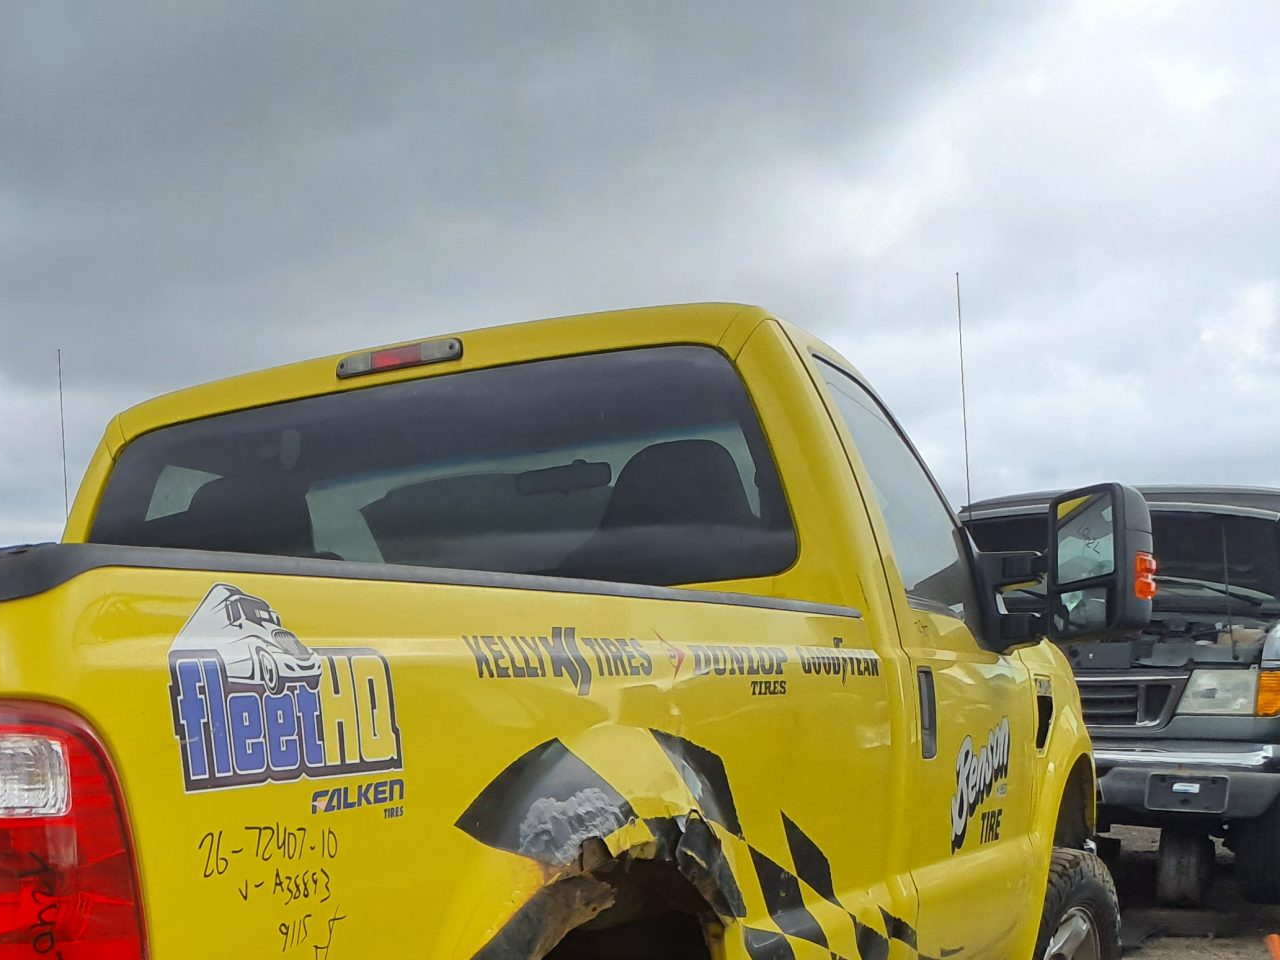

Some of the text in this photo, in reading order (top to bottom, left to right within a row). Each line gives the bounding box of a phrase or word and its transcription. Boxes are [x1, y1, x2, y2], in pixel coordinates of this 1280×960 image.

[461, 634, 548, 678] KELLY
[580, 637, 653, 677] TIRES
[686, 643, 789, 677] DUNLOP
[794, 645, 880, 677] GOODYEAR
[750, 679, 788, 696] TIRES
[311, 778, 405, 815] FALKEN
[951, 715, 1011, 856] Benson
[383, 805, 404, 820] TIRES
[980, 808, 1003, 845] TIRE
